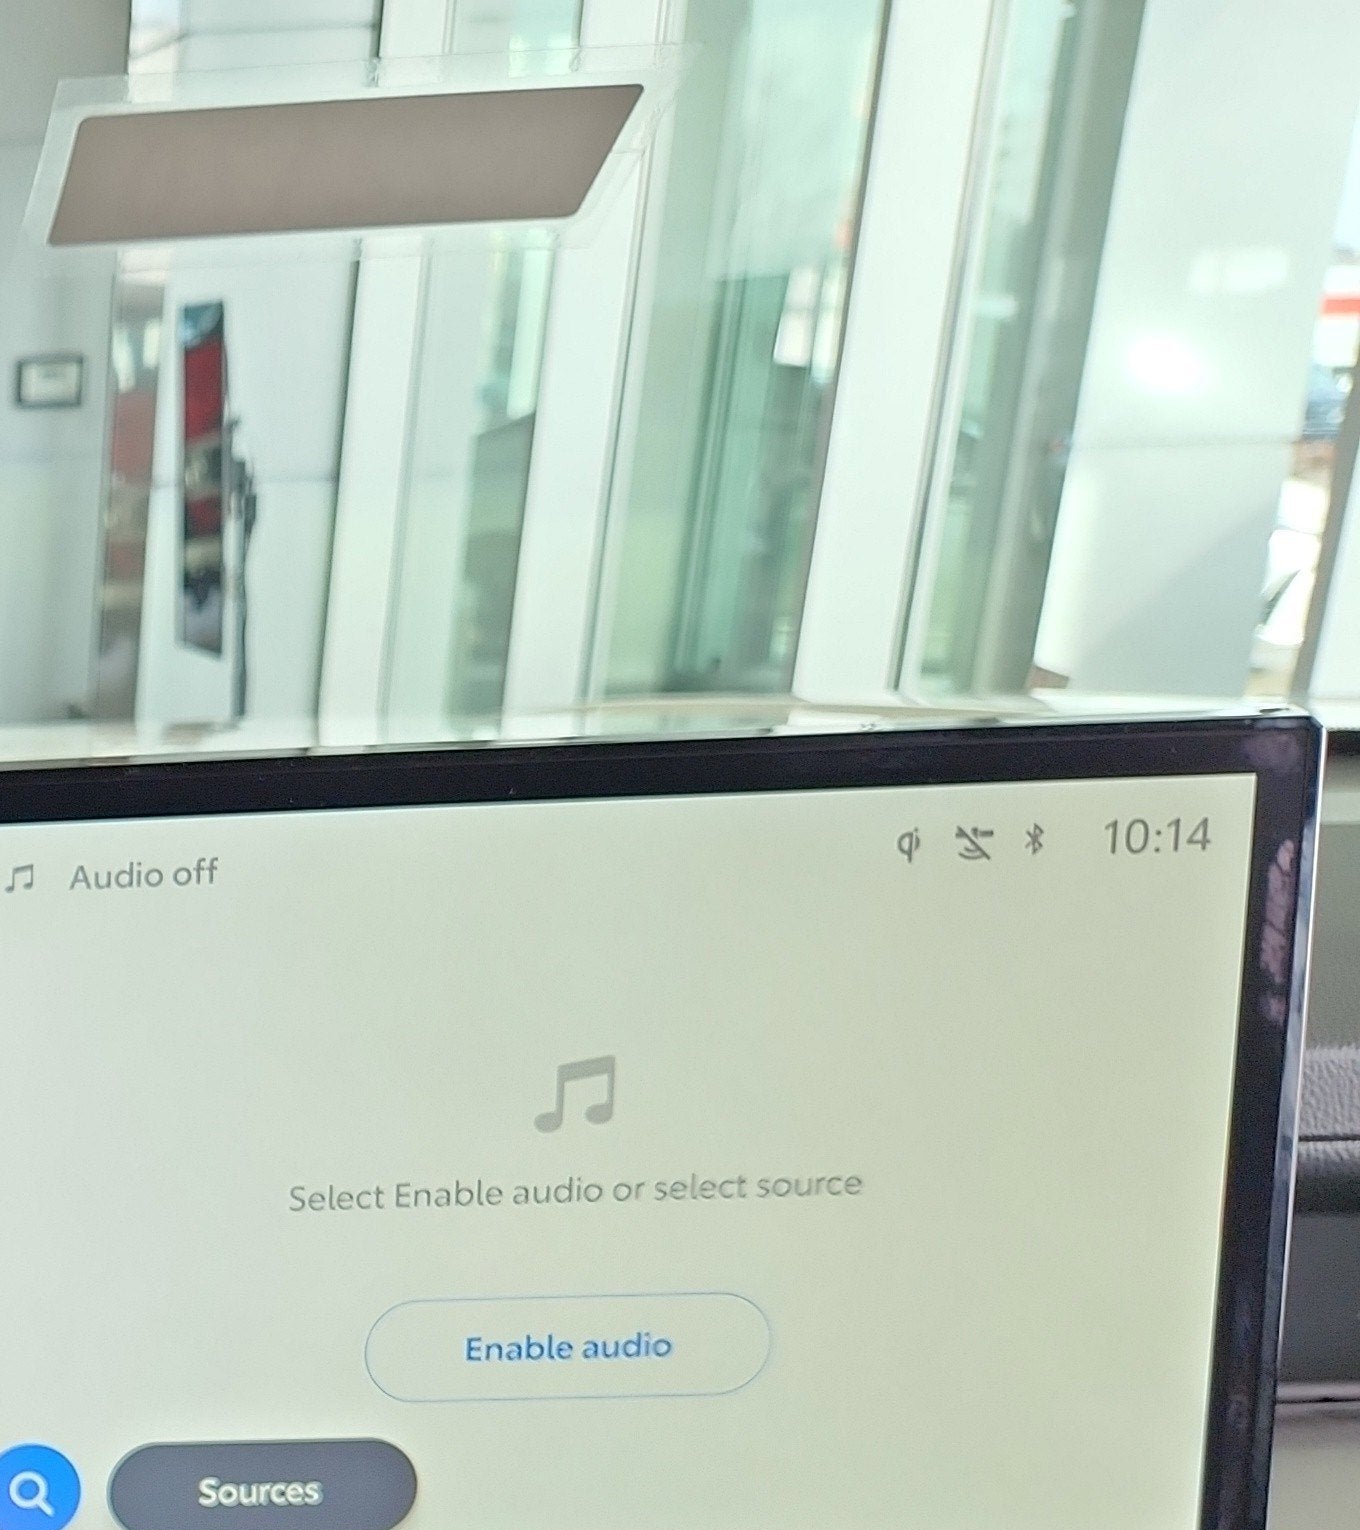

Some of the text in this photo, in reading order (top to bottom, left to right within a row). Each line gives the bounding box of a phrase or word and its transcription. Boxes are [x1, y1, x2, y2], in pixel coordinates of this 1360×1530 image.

[1104, 816, 1211, 854] 10:14
[68, 856, 219, 891] Audio off
[288, 1172, 863, 1212] Select Enable audio or select source
[466, 1331, 674, 1361] Enable audio
[197, 1475, 325, 1508] Sources
